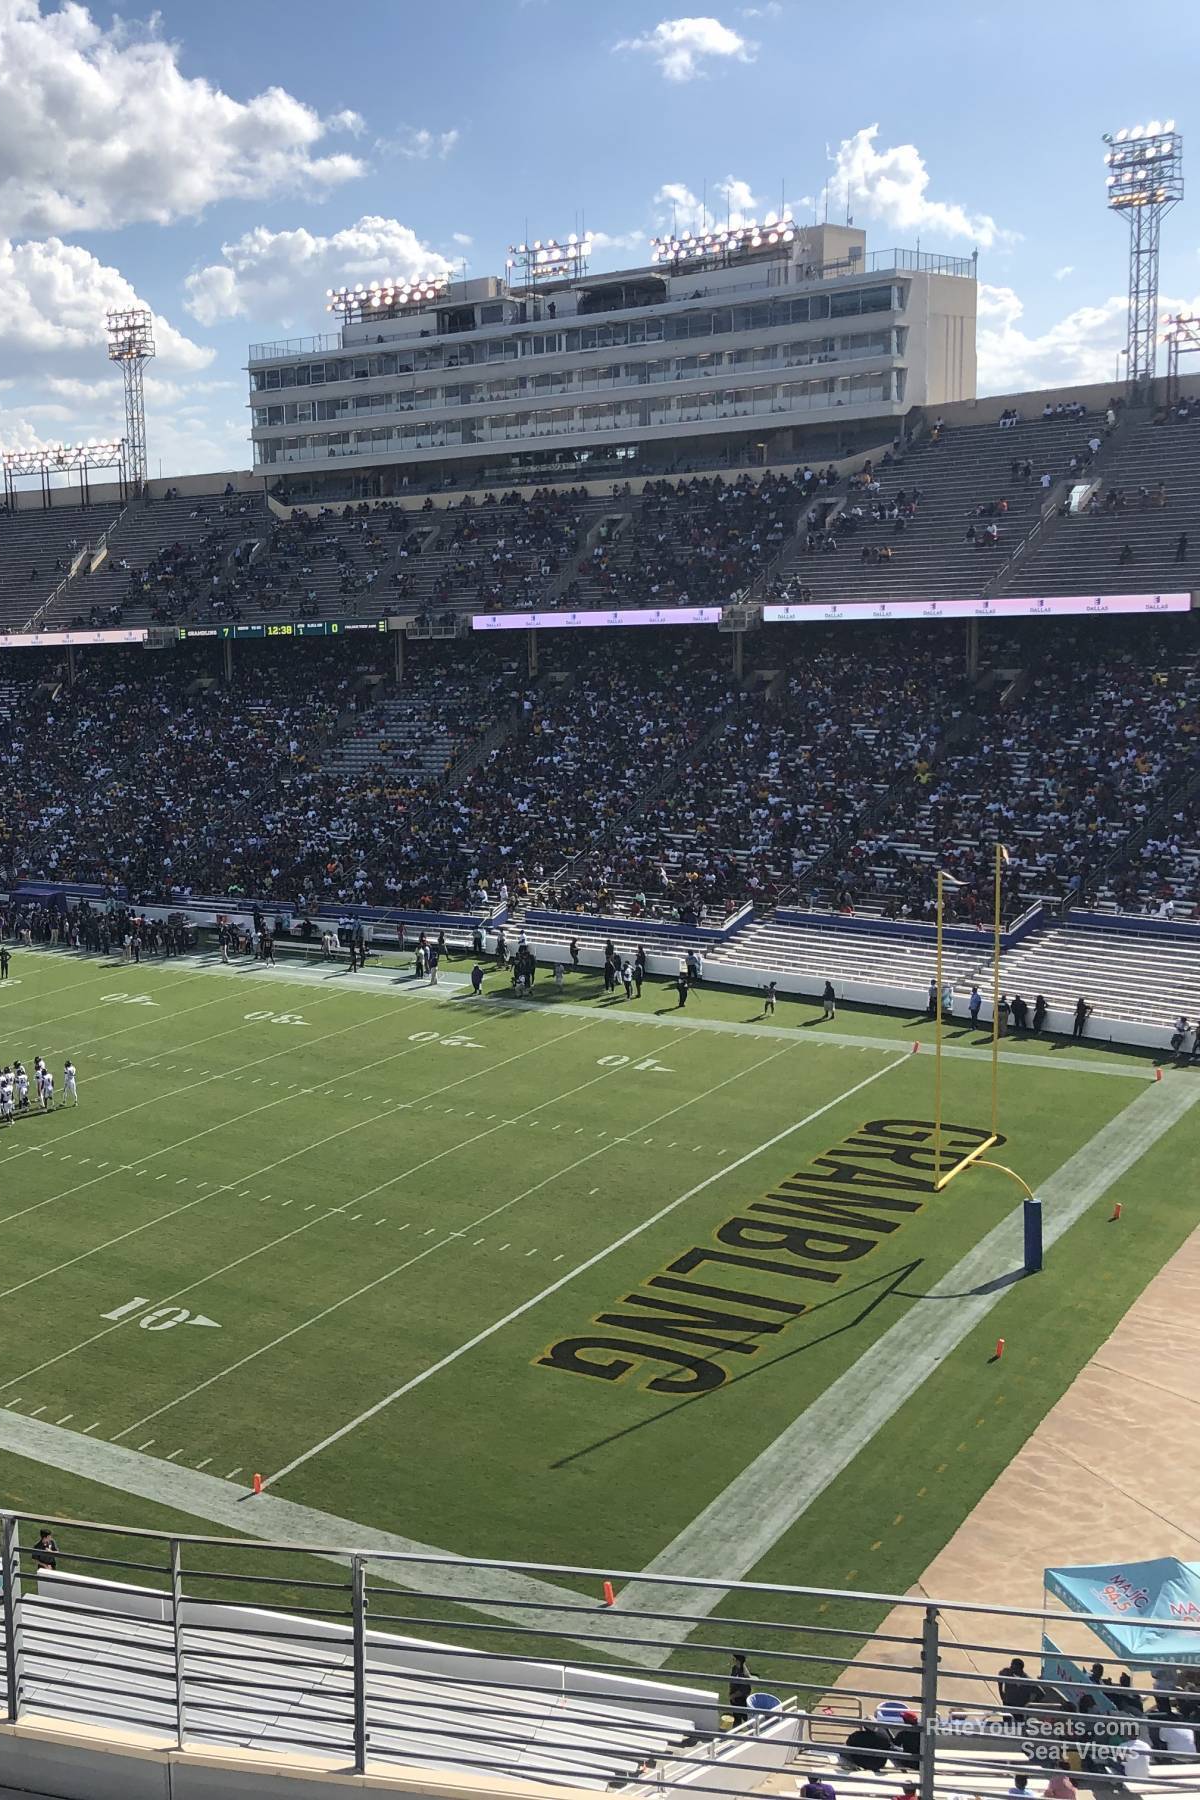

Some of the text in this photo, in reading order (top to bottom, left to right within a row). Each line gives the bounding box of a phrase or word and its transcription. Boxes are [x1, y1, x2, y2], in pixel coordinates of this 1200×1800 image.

[536, 1118, 1008, 1396] GRAMBLING
[100, 1297, 191, 1331] 10
[1103, 1585, 1132, 1612] 94.5
